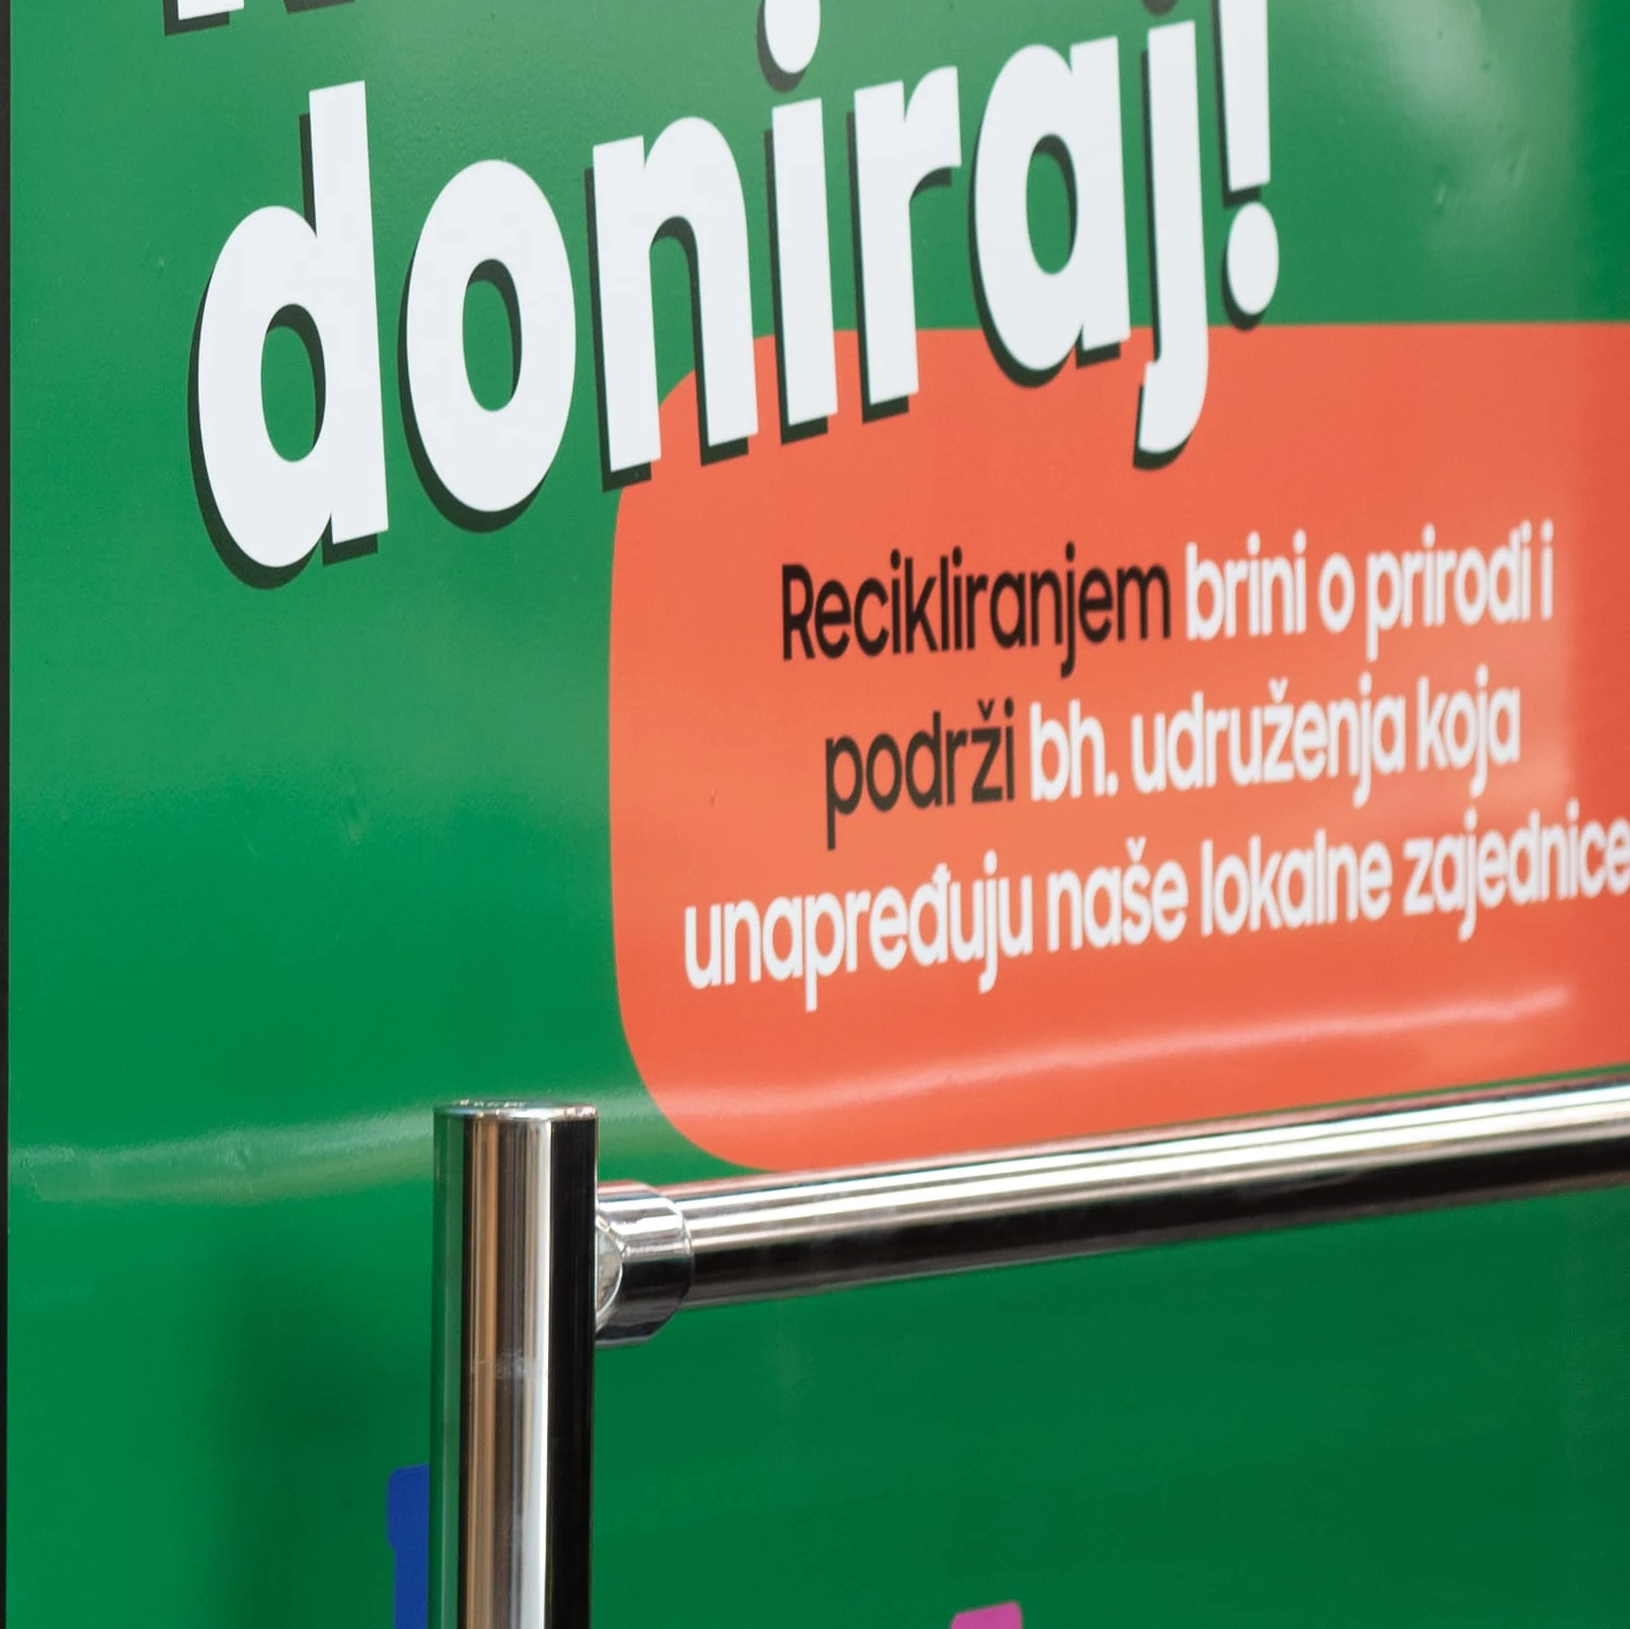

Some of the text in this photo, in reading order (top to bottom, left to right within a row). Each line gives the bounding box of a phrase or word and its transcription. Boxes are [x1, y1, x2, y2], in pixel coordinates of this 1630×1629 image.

[782, 519, 1554, 679] Recikliranjem brini o prirodi i
[825, 666, 1520, 850] podrži bh. udruženja koja
[685, 796, 1630, 1012] unapređuju naše lokalne zajednice
